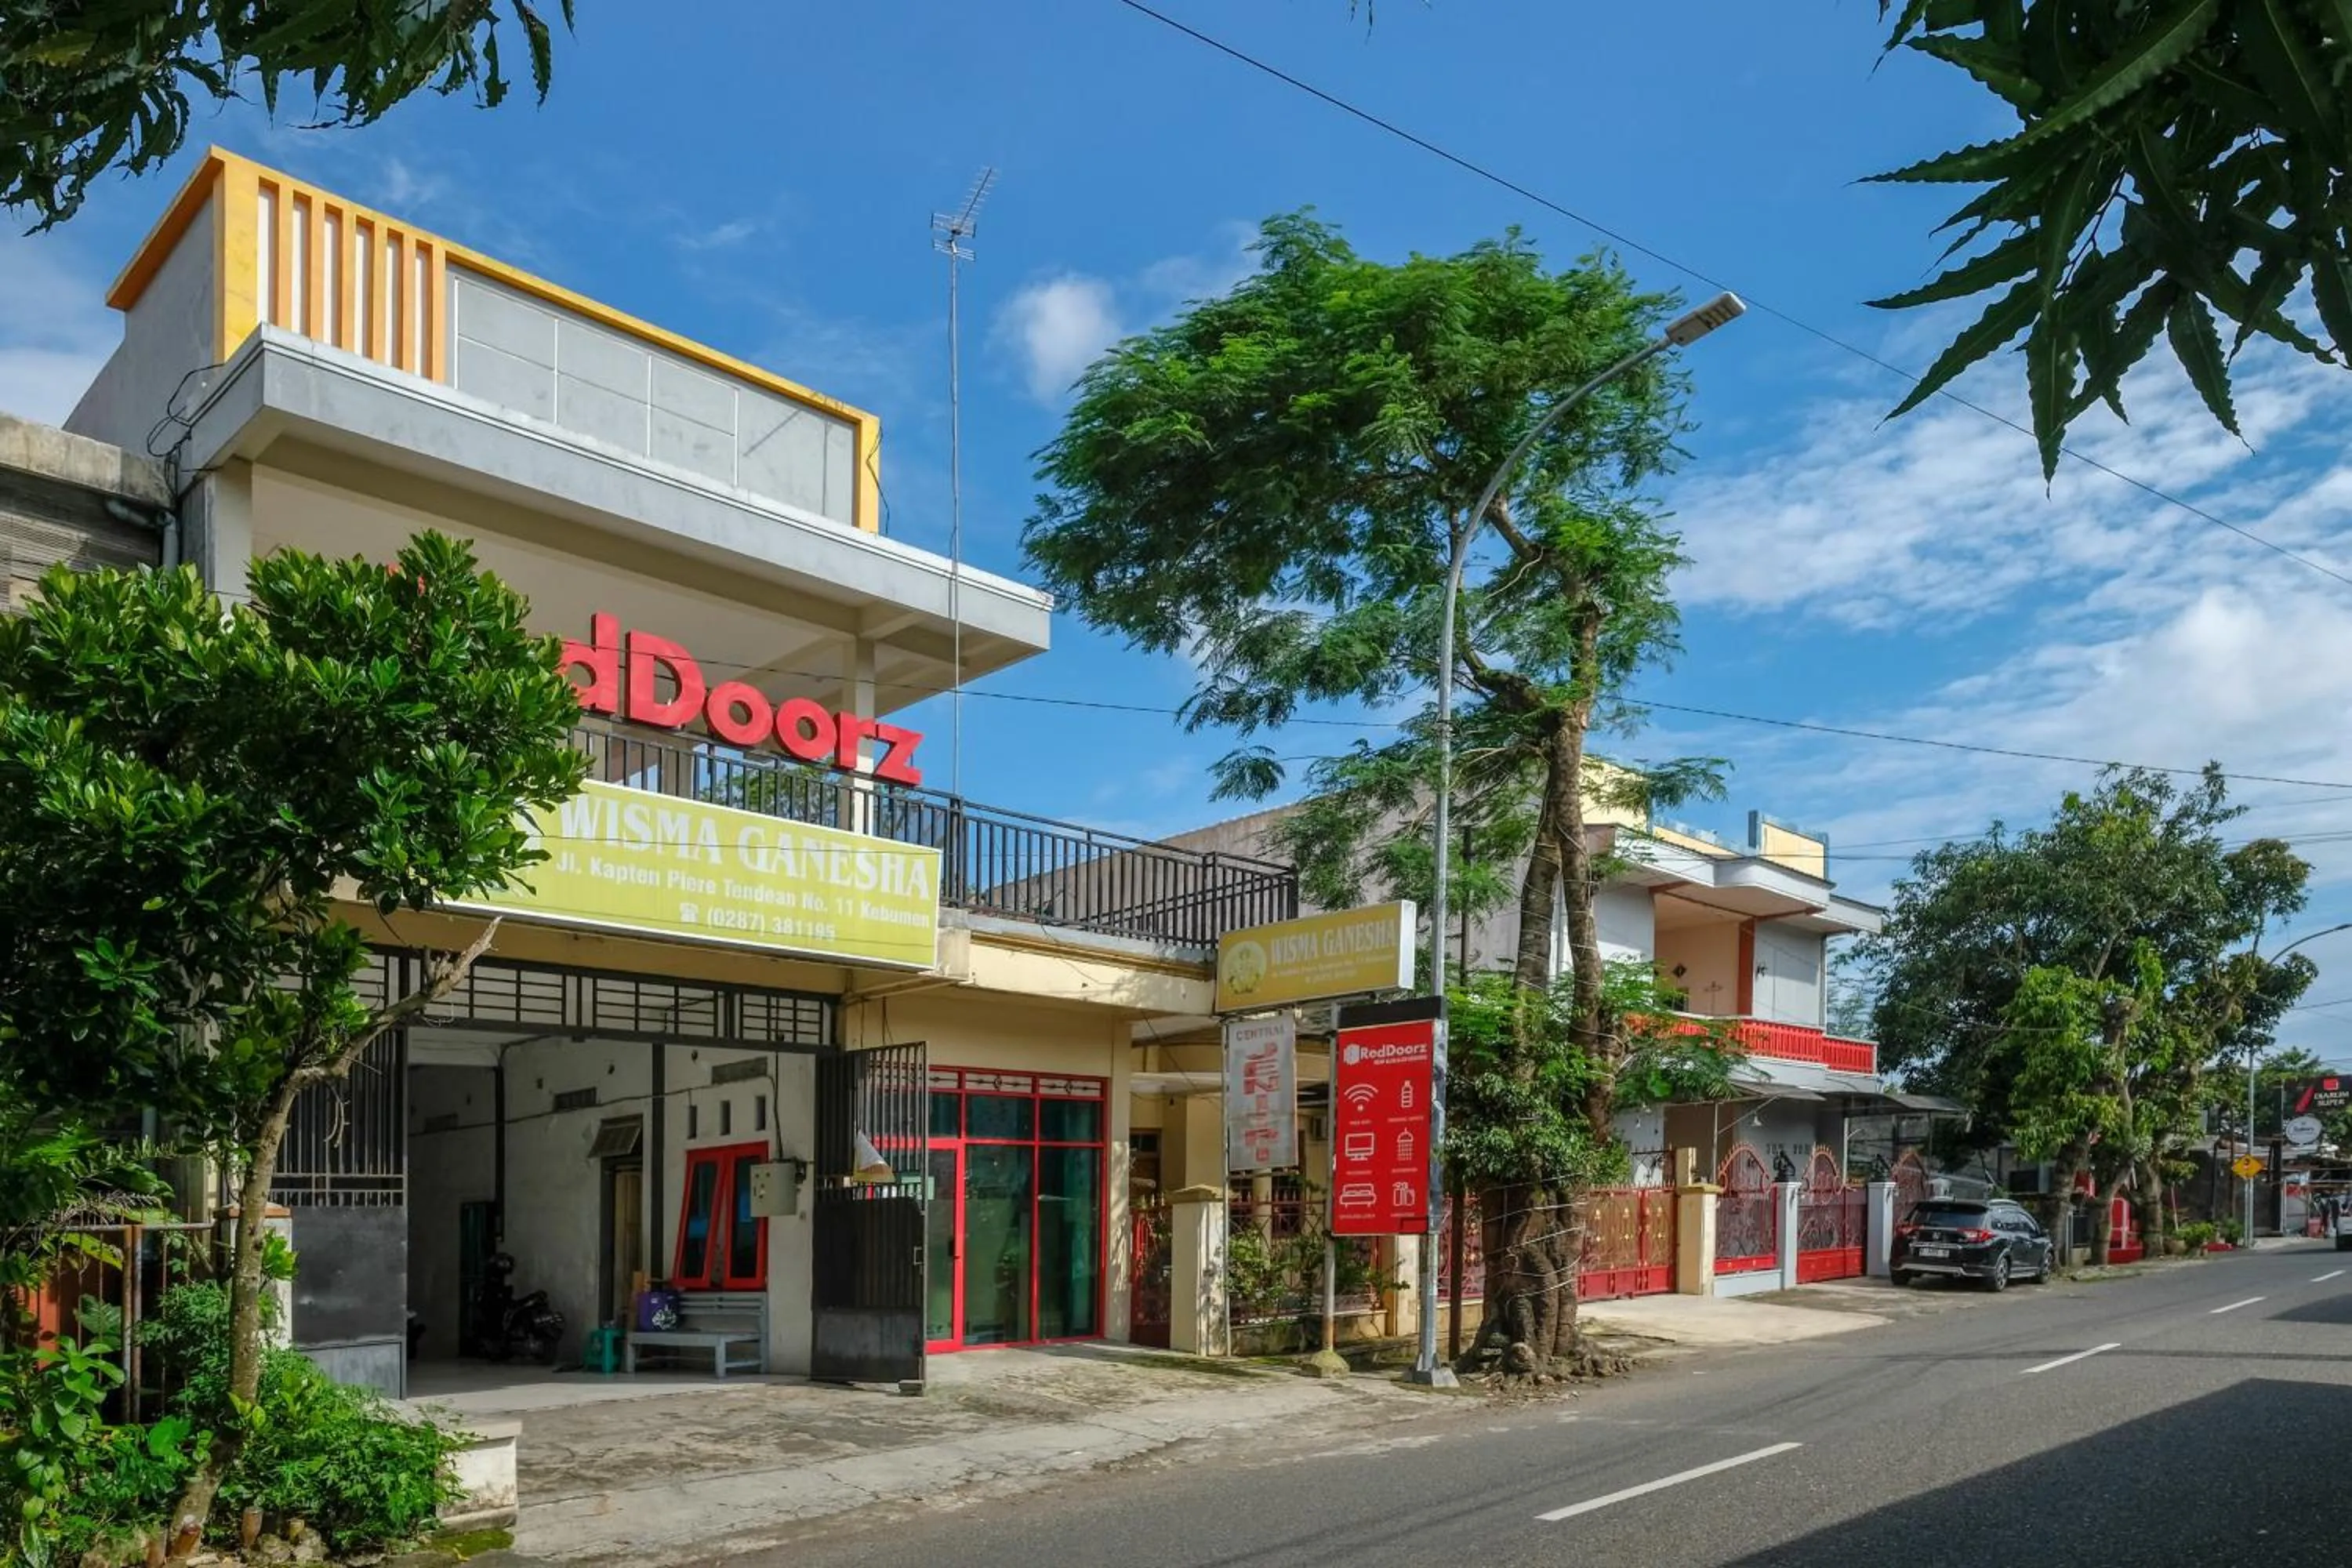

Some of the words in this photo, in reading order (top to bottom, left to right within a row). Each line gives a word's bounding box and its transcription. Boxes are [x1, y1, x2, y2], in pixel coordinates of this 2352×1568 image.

[555, 612, 924, 786] dDoorz
[561, 793, 722, 865] WISMA
[737, 826, 930, 900] GANESHA
[557, 851, 582, 874] Jl.
[590, 856, 660, 886] Kapten
[667, 869, 716, 895] Piere
[724, 878, 796, 906] Tendean
[802, 892, 828, 911] No.
[837, 898, 853, 917] 11
[862, 901, 930, 928] Kebumen
[708, 906, 765, 936] (0287)
[1270, 931, 1319, 965] WISMA
[1323, 918, 1396, 955] GANESHA
[1360, 1044, 1427, 1059] RedDoorz
